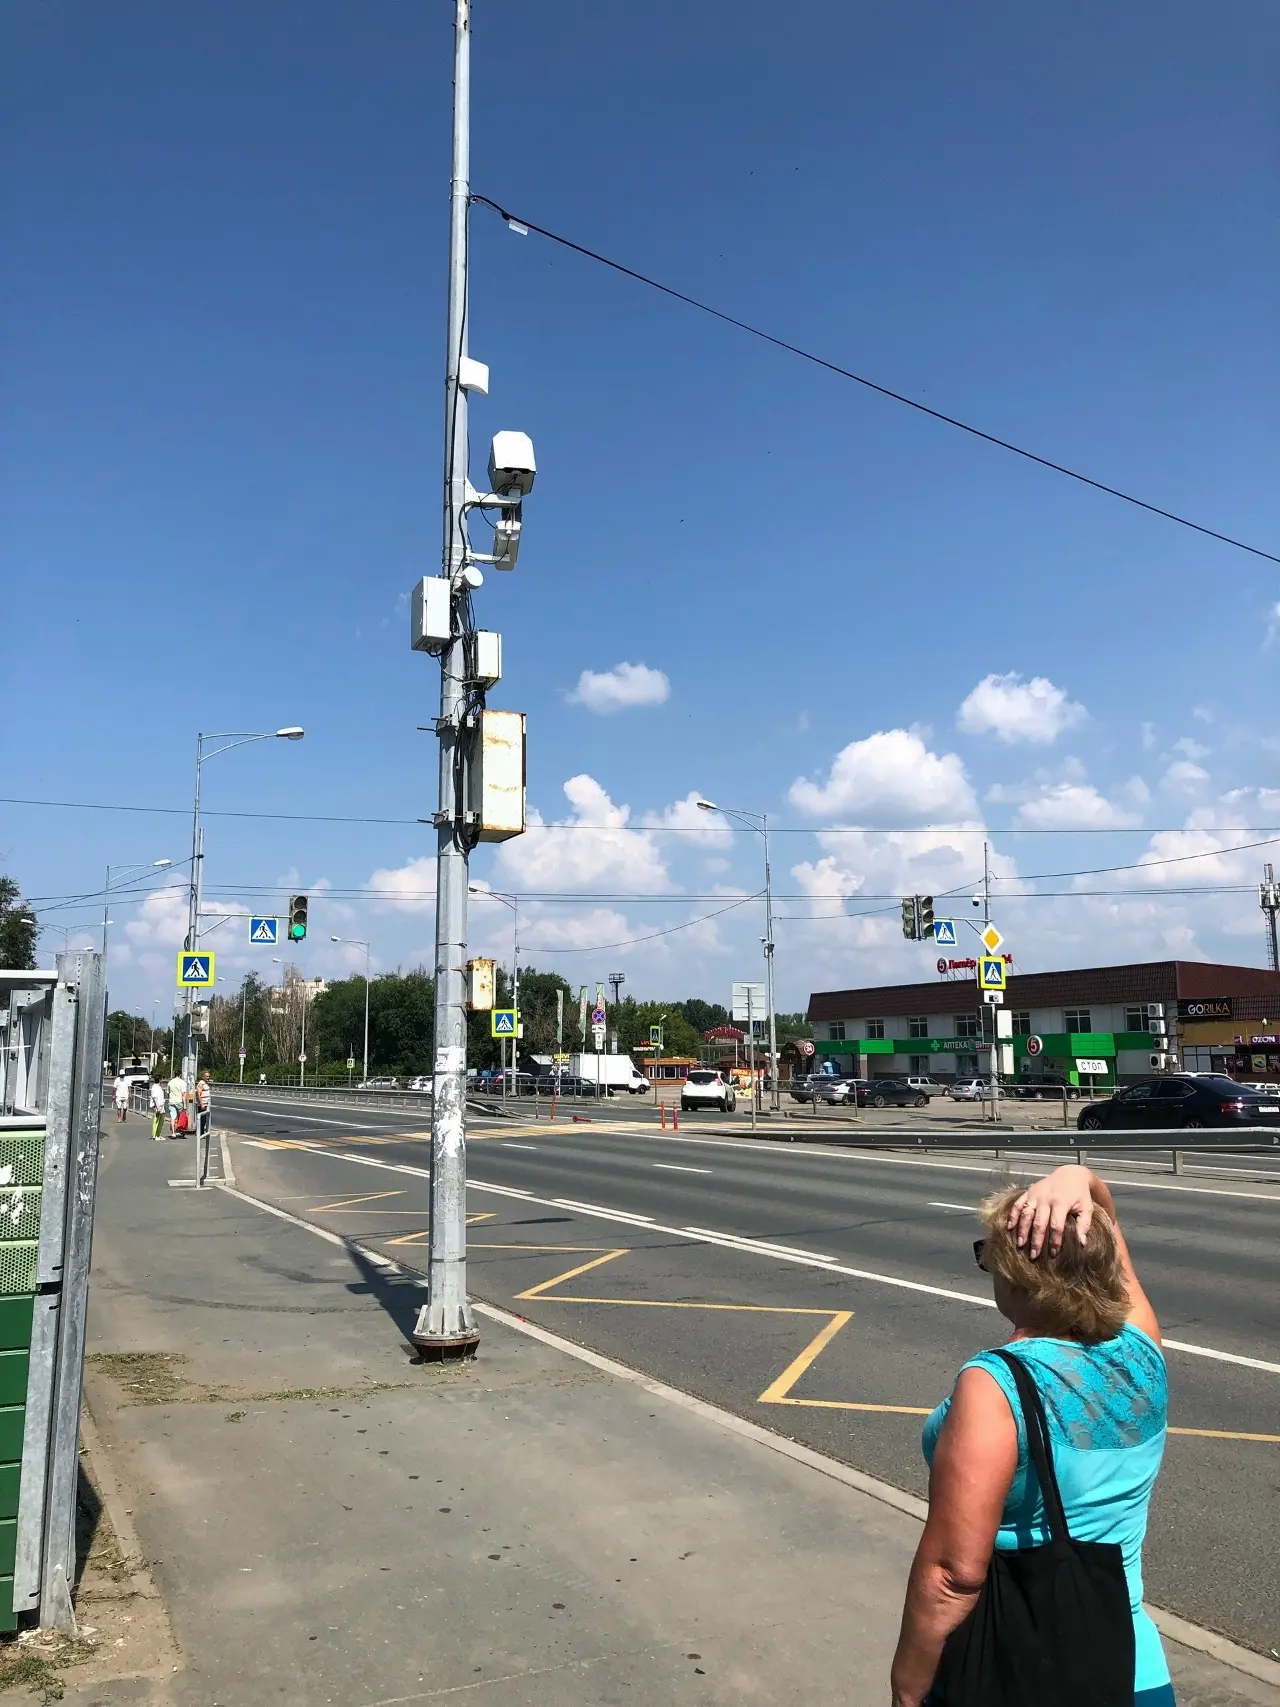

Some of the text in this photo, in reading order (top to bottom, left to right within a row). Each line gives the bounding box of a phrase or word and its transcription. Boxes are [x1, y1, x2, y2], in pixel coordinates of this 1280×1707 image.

[1187, 1003, 1230, 1014] GORILKA
[943, 1041, 967, 1049] АПТЕКА
[1081, 1061, 1103, 1071] СТОП
